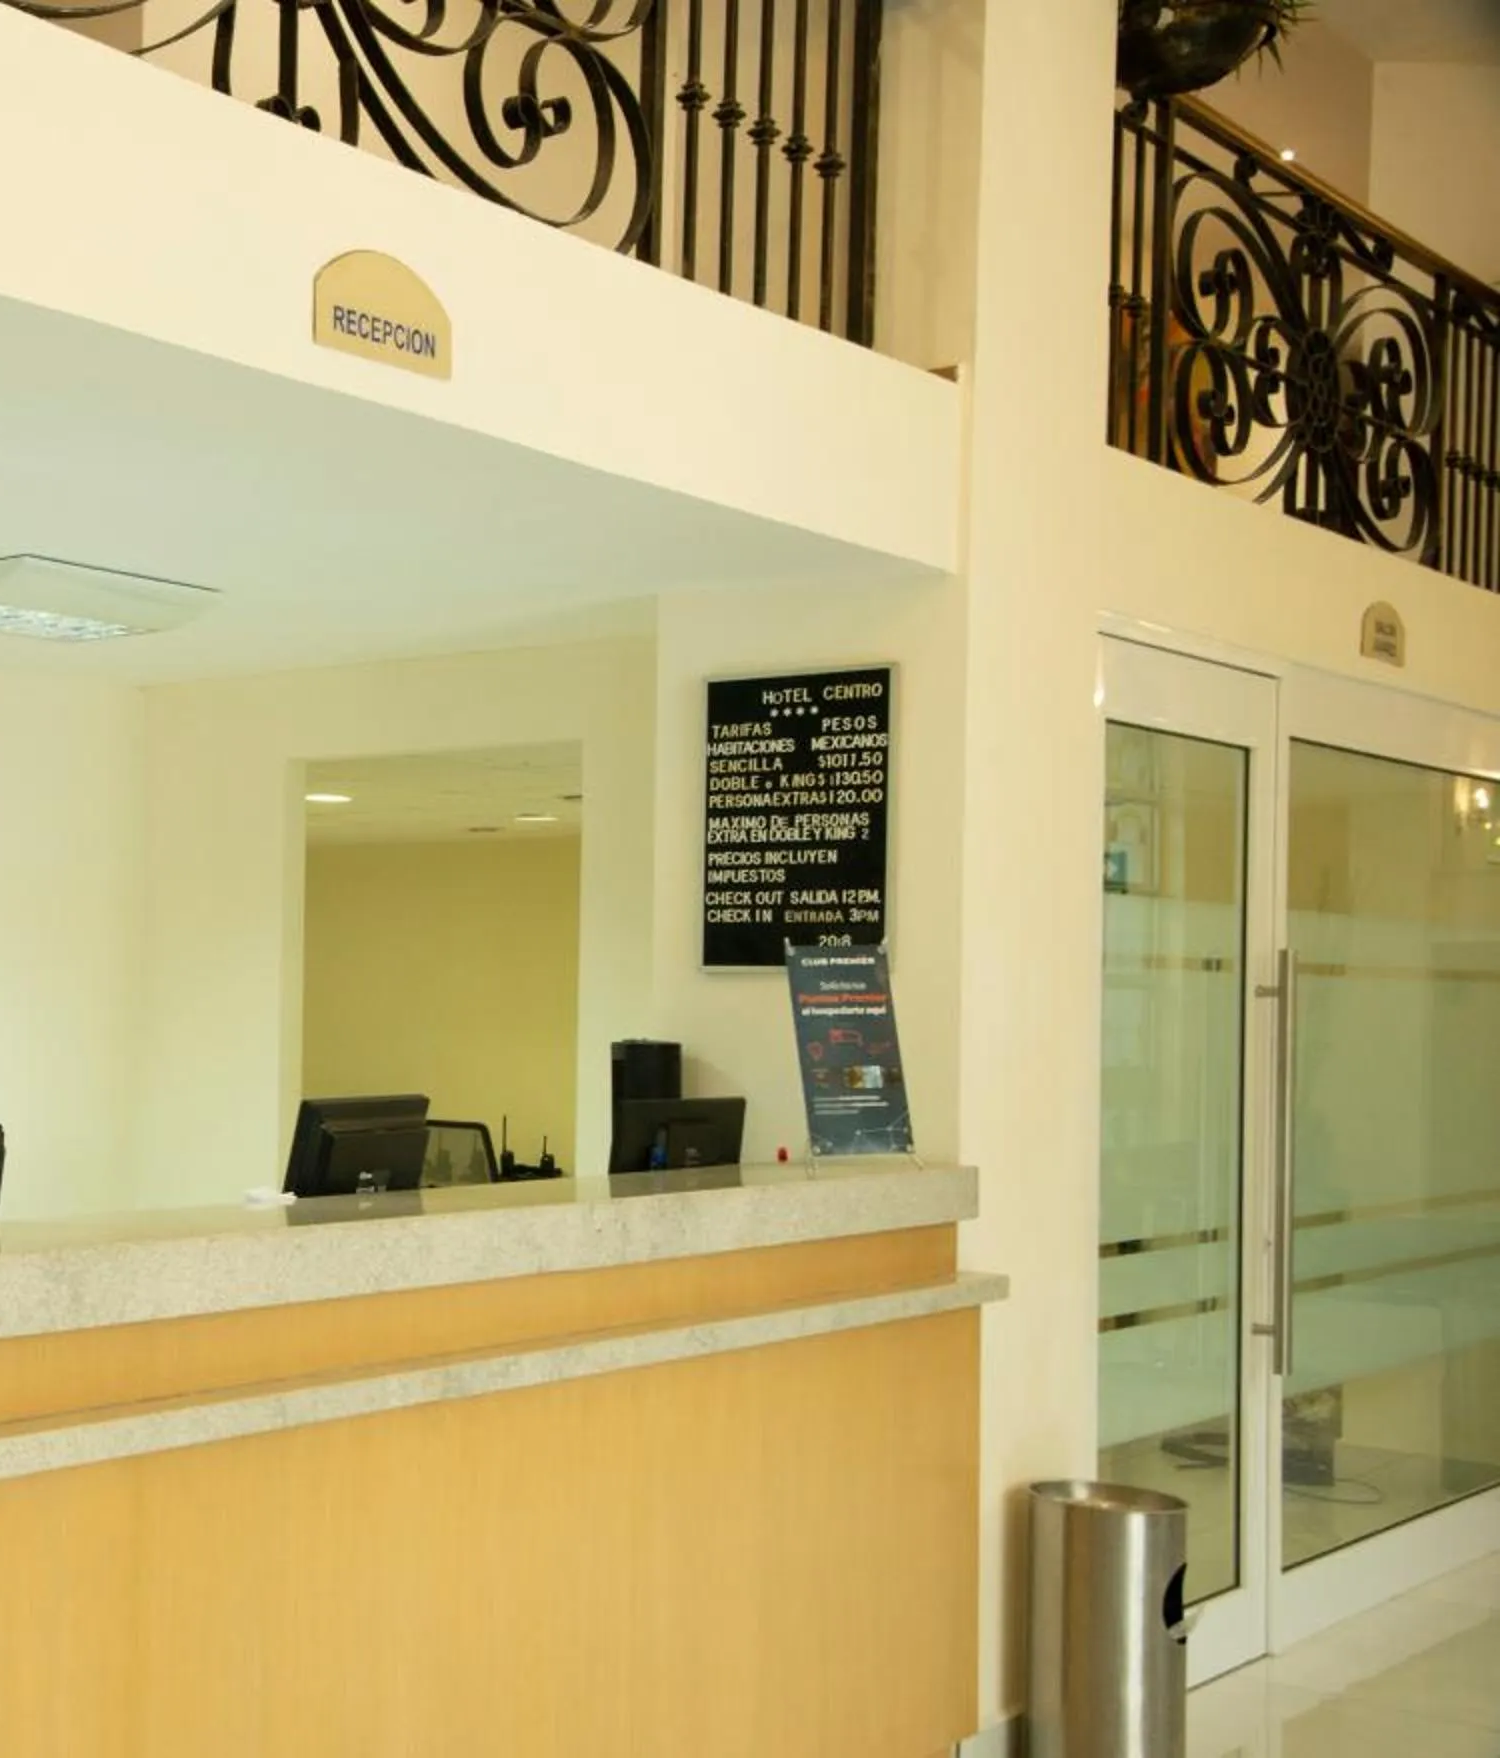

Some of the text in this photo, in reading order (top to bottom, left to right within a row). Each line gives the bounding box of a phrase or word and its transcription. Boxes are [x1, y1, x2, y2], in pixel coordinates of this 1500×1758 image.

[332, 304, 436, 360] RECEPCION
[823, 682, 883, 700] CENTRO
[711, 714, 878, 739] TARIFAS PESOS
[707, 732, 888, 756] HABITACIONES MEXICANOS
[709, 757, 784, 774] SENCILLA
[709, 775, 762, 791] DOBLE
[708, 812, 870, 831] MAXIMO DE PERSONAS
[706, 830, 749, 845] EXTRA
[751, 829, 767, 844] EN
[824, 826, 857, 842] KING
[861, 828, 870, 841] 2
[707, 849, 838, 867] PRECIOS INCLUYEN
[707, 869, 786, 884] IMPUESTOS
[705, 890, 751, 906] CHECK
[755, 890, 785, 905] OUT
[789, 888, 838, 905] SALIDA
[706, 908, 751, 924] CHECK
[755, 908, 773, 923] IN
[783, 909, 845, 924] ENTRADA
